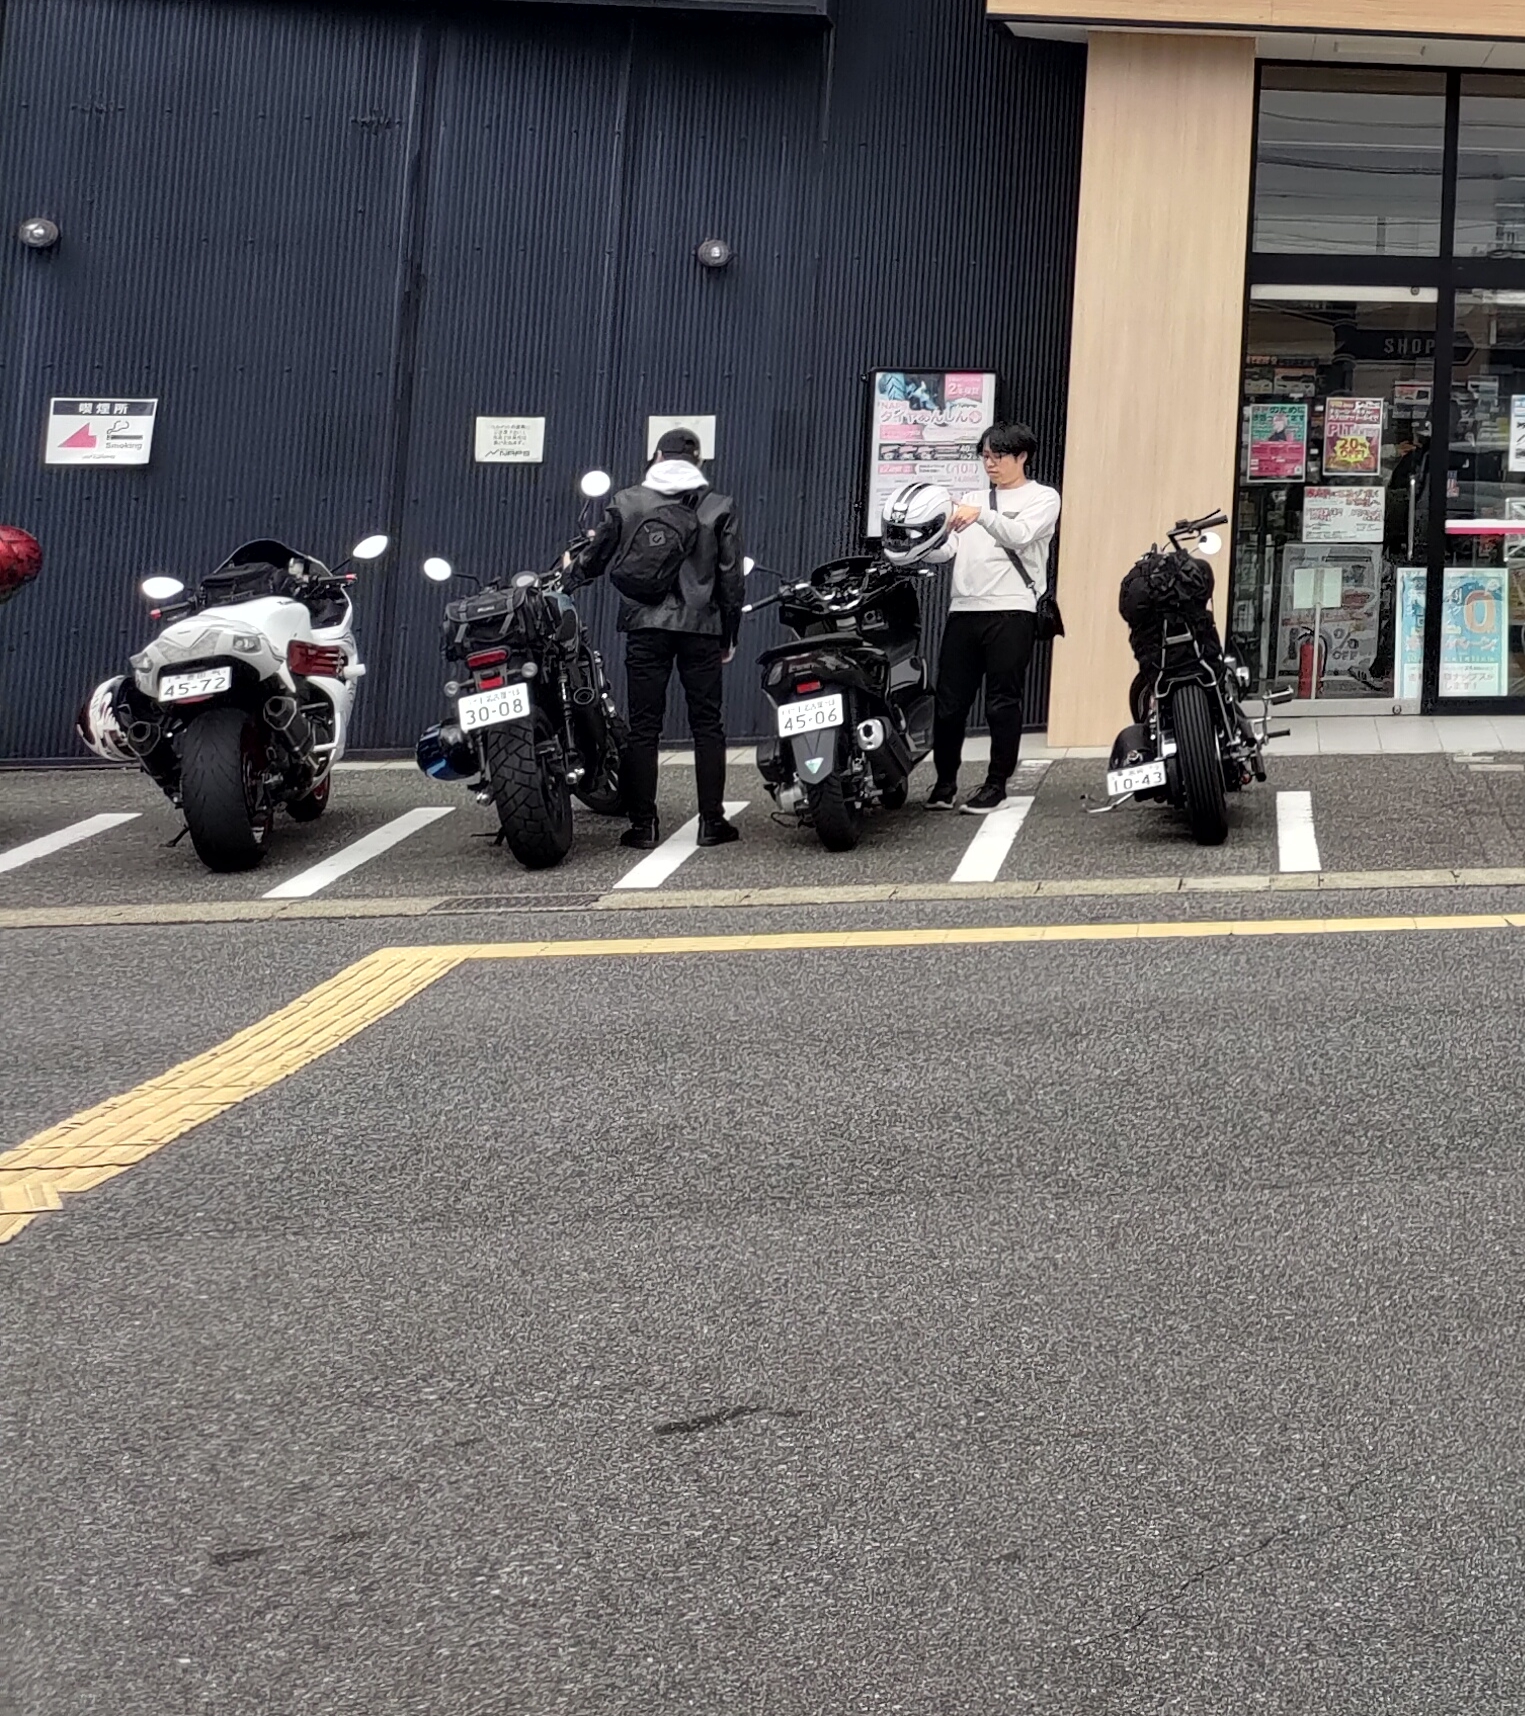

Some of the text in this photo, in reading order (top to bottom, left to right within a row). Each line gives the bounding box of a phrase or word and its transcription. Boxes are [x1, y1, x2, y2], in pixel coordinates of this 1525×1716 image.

[1384, 338, 1436, 354] SHOP
[78, 402, 130, 415] 喫煙所
[164, 677, 226, 697] 45-72
[466, 698, 523, 725] 30-08
[784, 708, 837, 731] 45-06
[1114, 772, 1162, 792] 10-43
